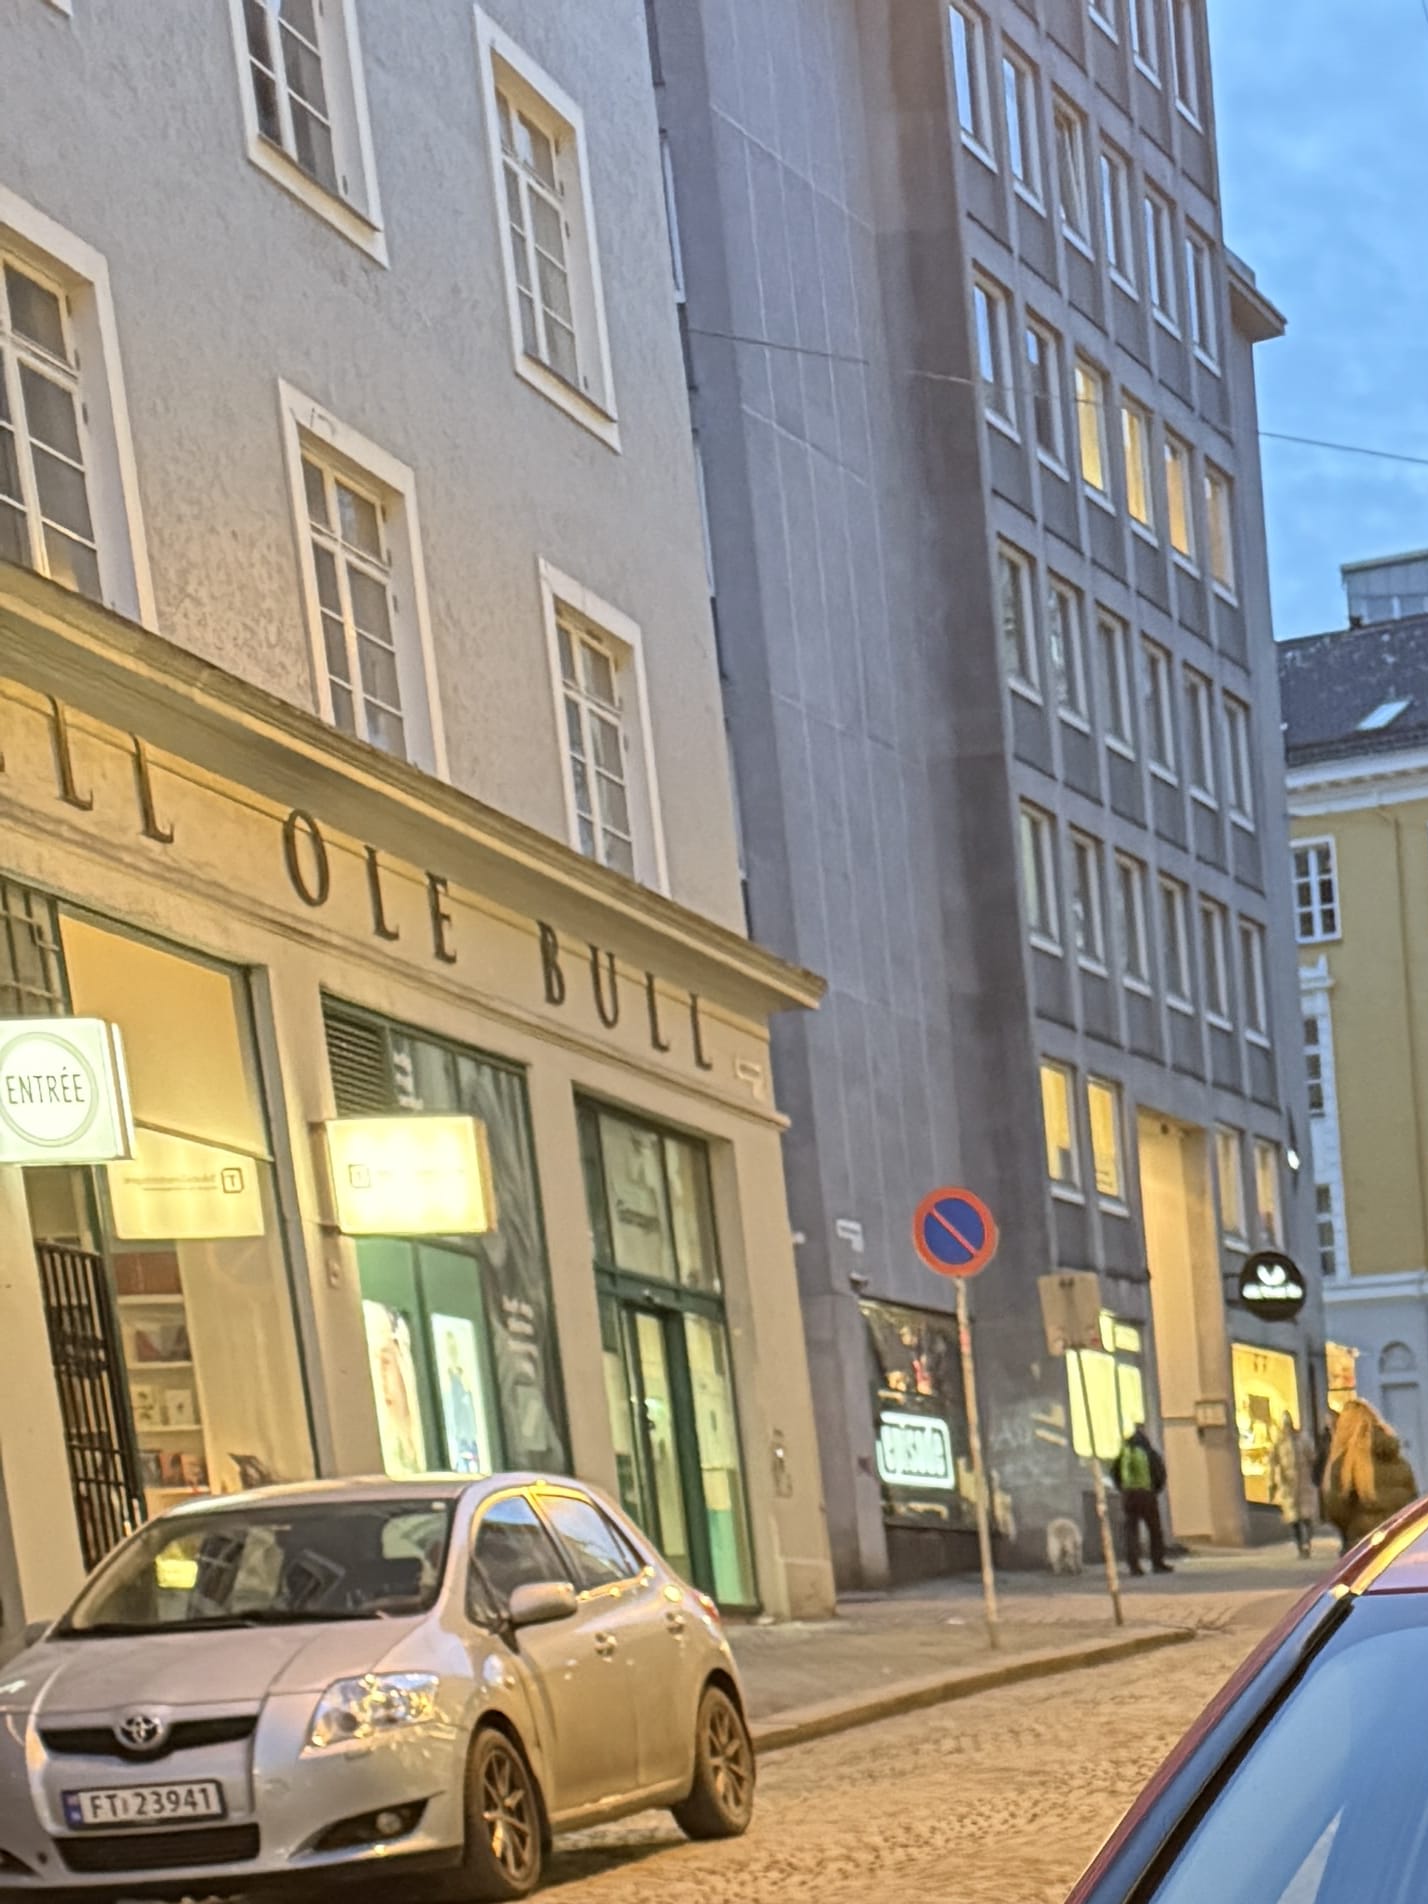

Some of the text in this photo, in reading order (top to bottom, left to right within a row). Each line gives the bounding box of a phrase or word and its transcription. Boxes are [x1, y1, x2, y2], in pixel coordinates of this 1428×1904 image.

[0, 692, 714, 1071] LL OLE BULL
[5, 1066, 86, 1105] ENTRÉE
[90, 1788, 212, 1819] FT 23941
